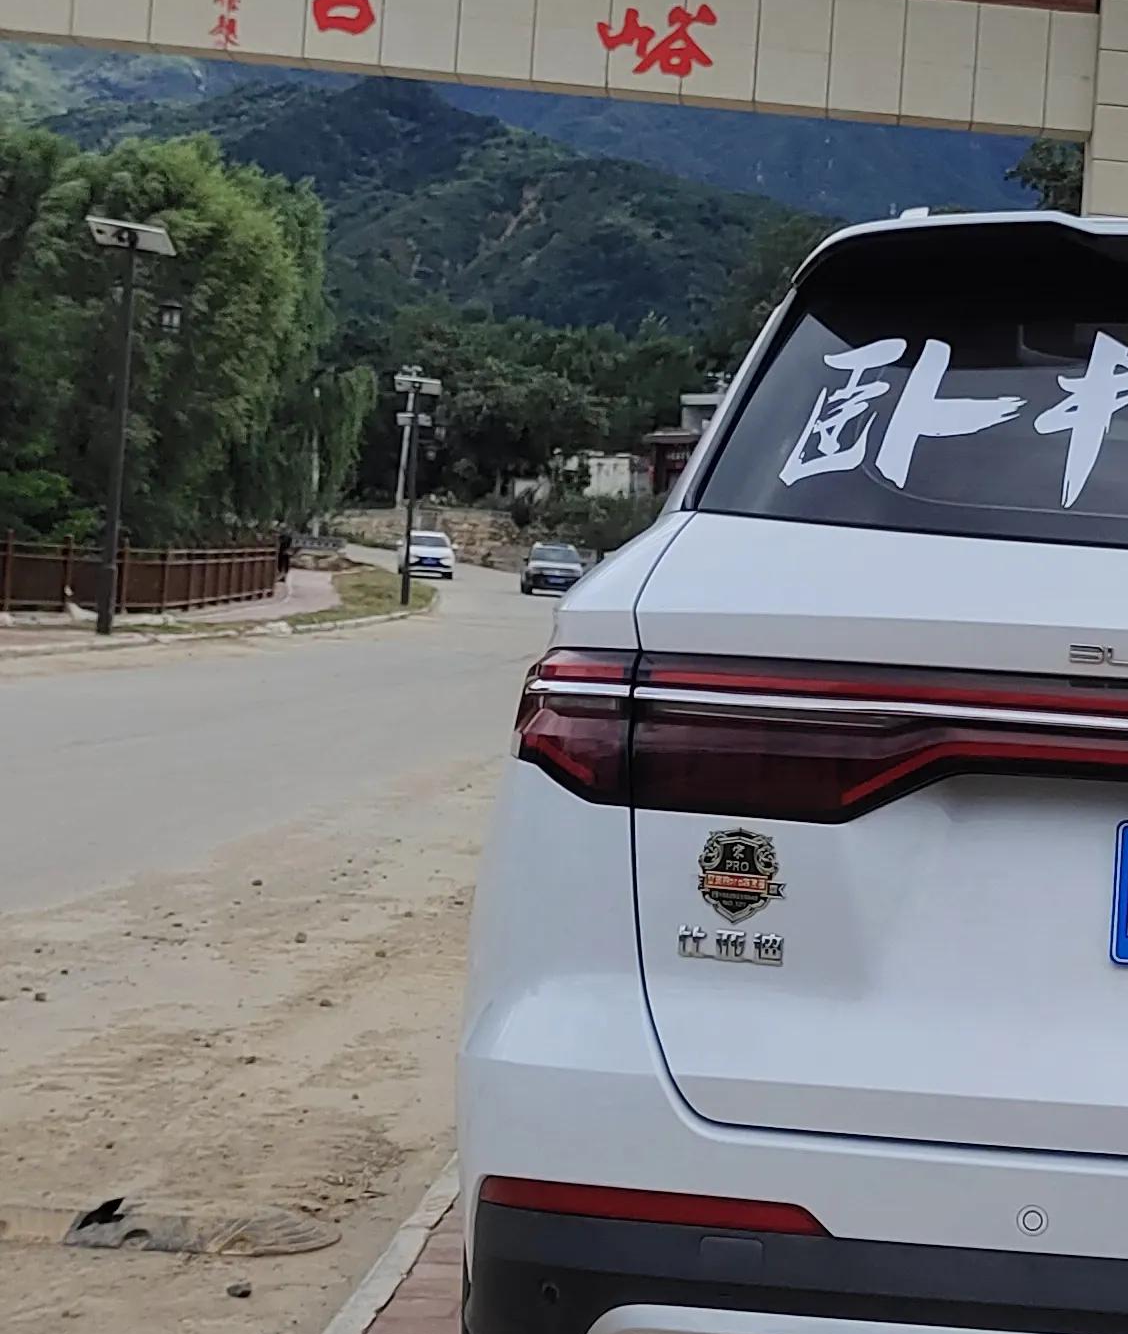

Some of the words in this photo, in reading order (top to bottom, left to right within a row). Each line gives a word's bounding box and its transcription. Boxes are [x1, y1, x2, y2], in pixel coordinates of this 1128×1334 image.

[725, 859, 750, 872] PRO
[678, 925, 784, 966] 比亚迪
